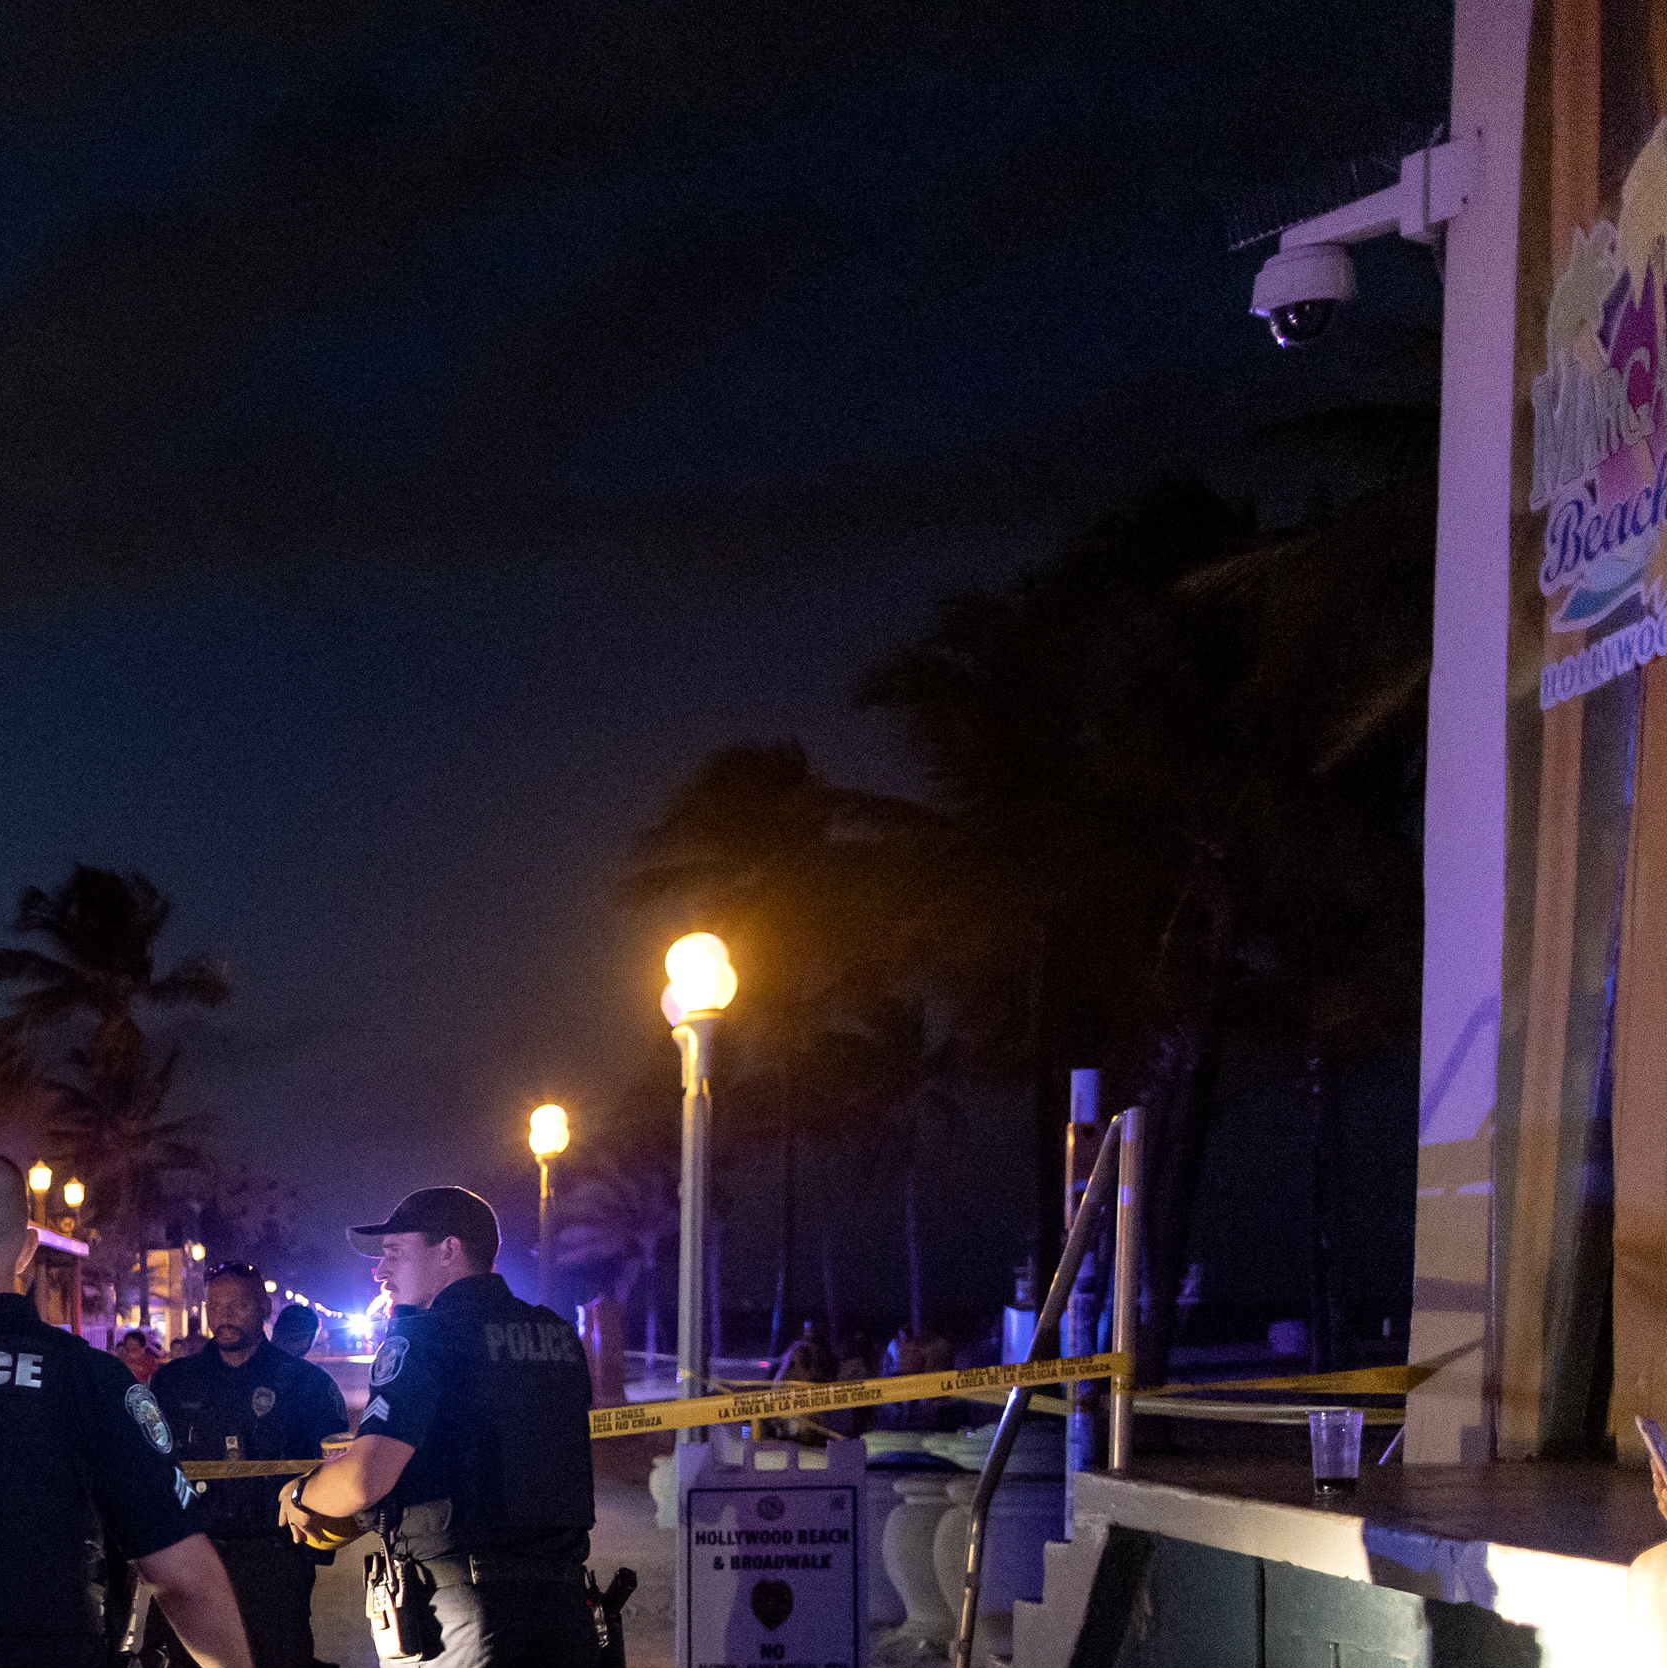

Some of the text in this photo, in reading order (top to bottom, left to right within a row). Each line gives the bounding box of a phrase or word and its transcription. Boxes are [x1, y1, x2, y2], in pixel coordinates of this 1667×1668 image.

[486, 1321, 578, 1361] POLICE
[592, 1421, 613, 1434] ICIA
[695, 1528, 849, 1546] HOLLYWOOD BEACH
[713, 1554, 832, 1570] & BROADWALK
[760, 1643, 785, 1659] NO
